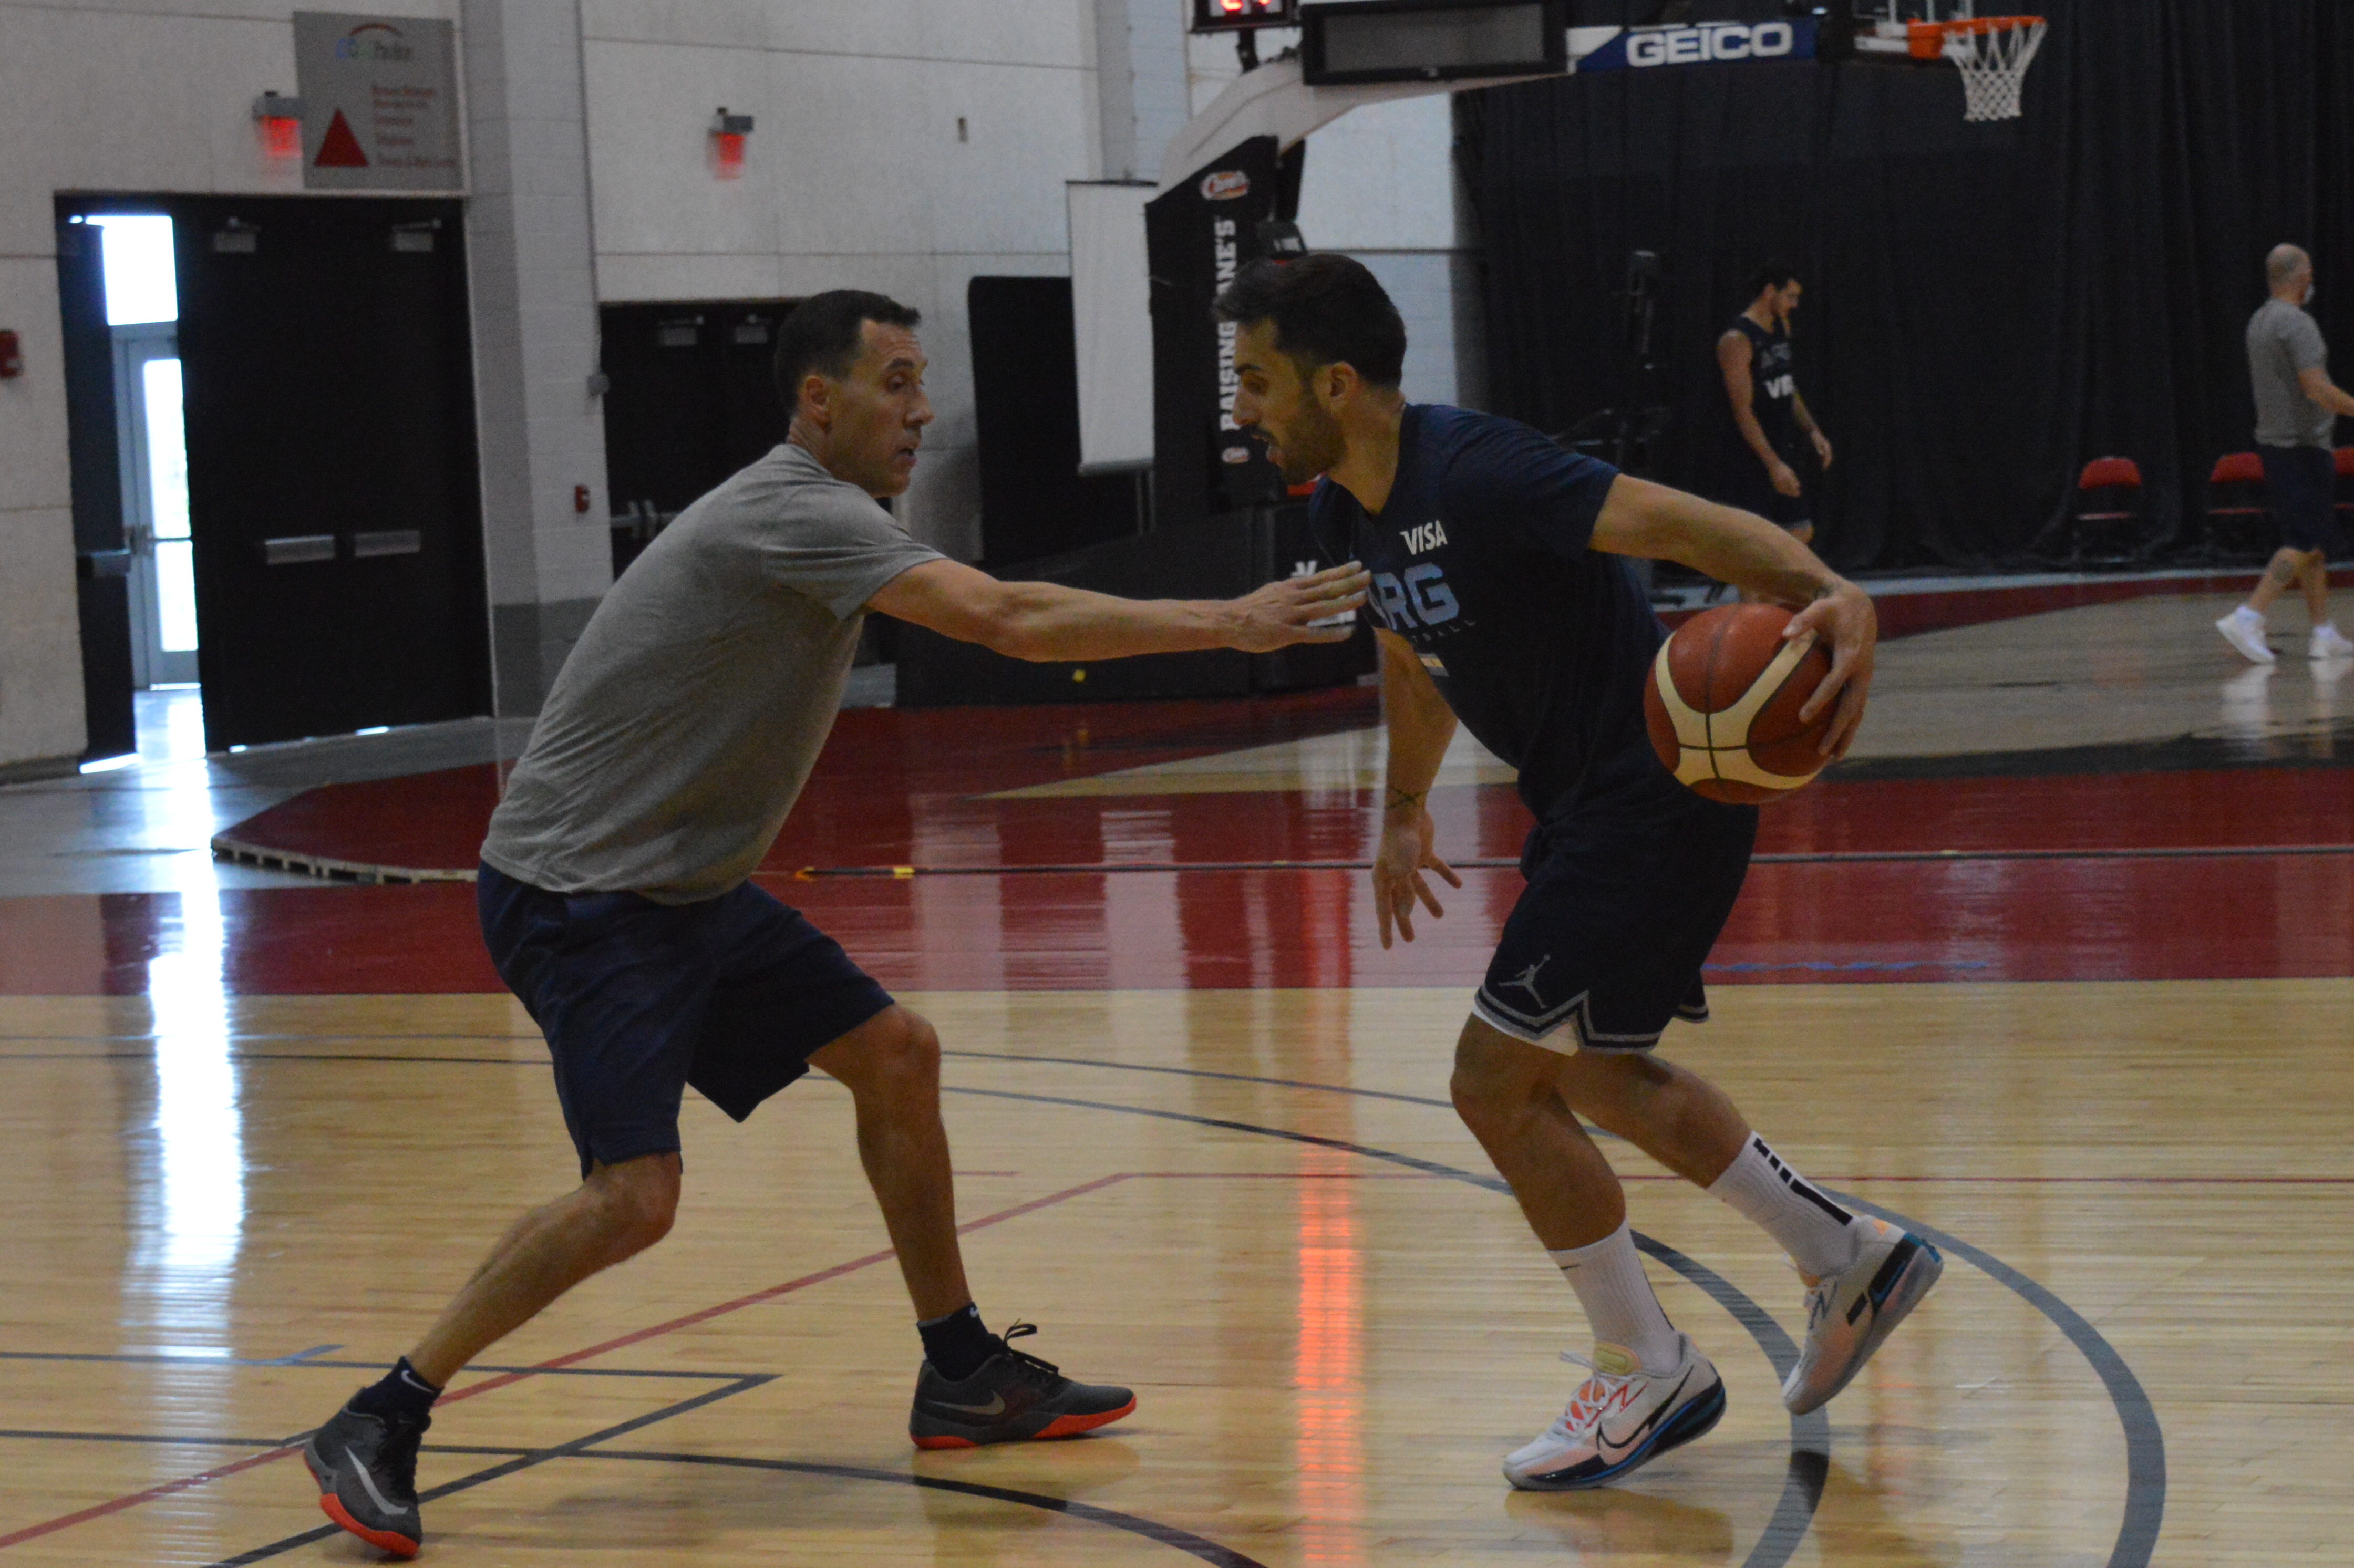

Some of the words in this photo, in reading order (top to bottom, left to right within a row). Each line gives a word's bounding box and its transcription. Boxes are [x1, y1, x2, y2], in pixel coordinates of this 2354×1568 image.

[1625, 22, 1794, 67] GEICO
[1214, 216, 1238, 295] ANE'S
[1217, 321, 1241, 431] RAISING
[1399, 519, 1449, 555] VISA
